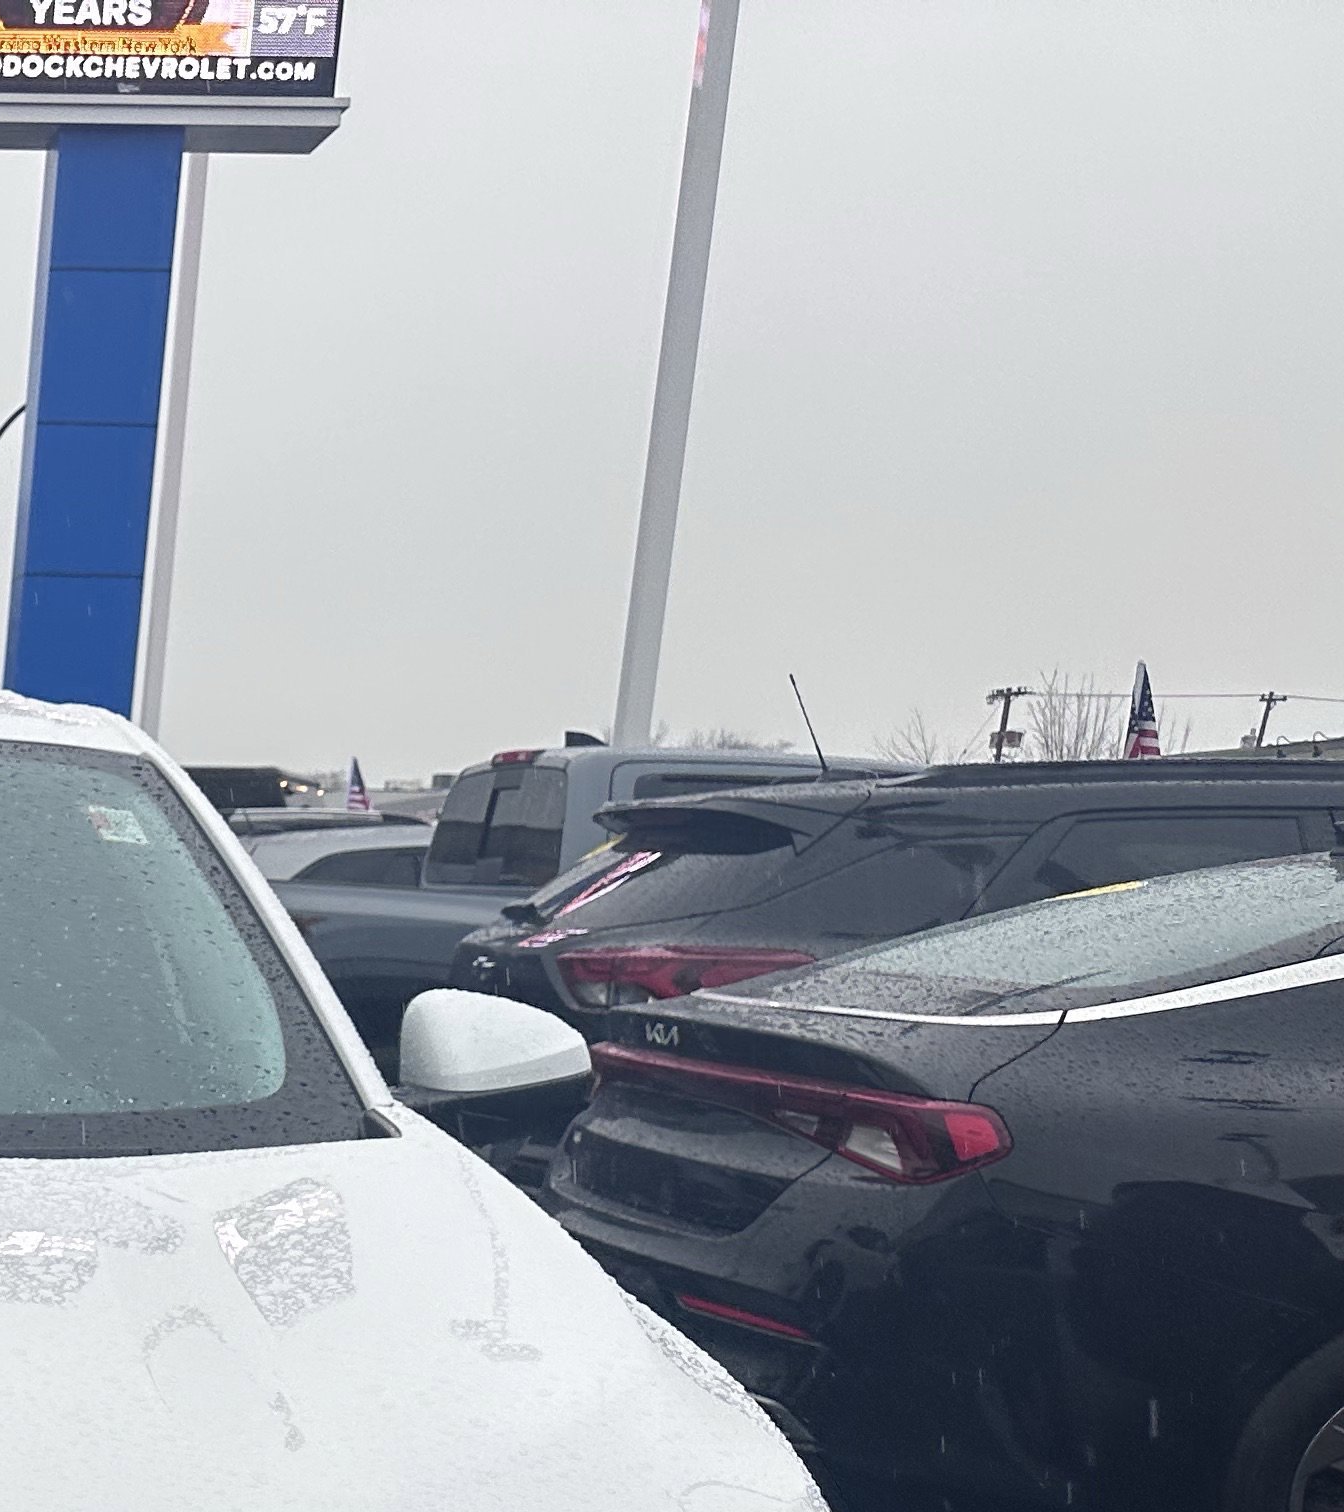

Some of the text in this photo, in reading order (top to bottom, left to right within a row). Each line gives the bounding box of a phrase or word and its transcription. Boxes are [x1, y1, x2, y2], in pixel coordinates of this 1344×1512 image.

[31, 0, 152, 26] YEARS
[118, 37, 157, 53] New
[159, 36, 197, 54] York
